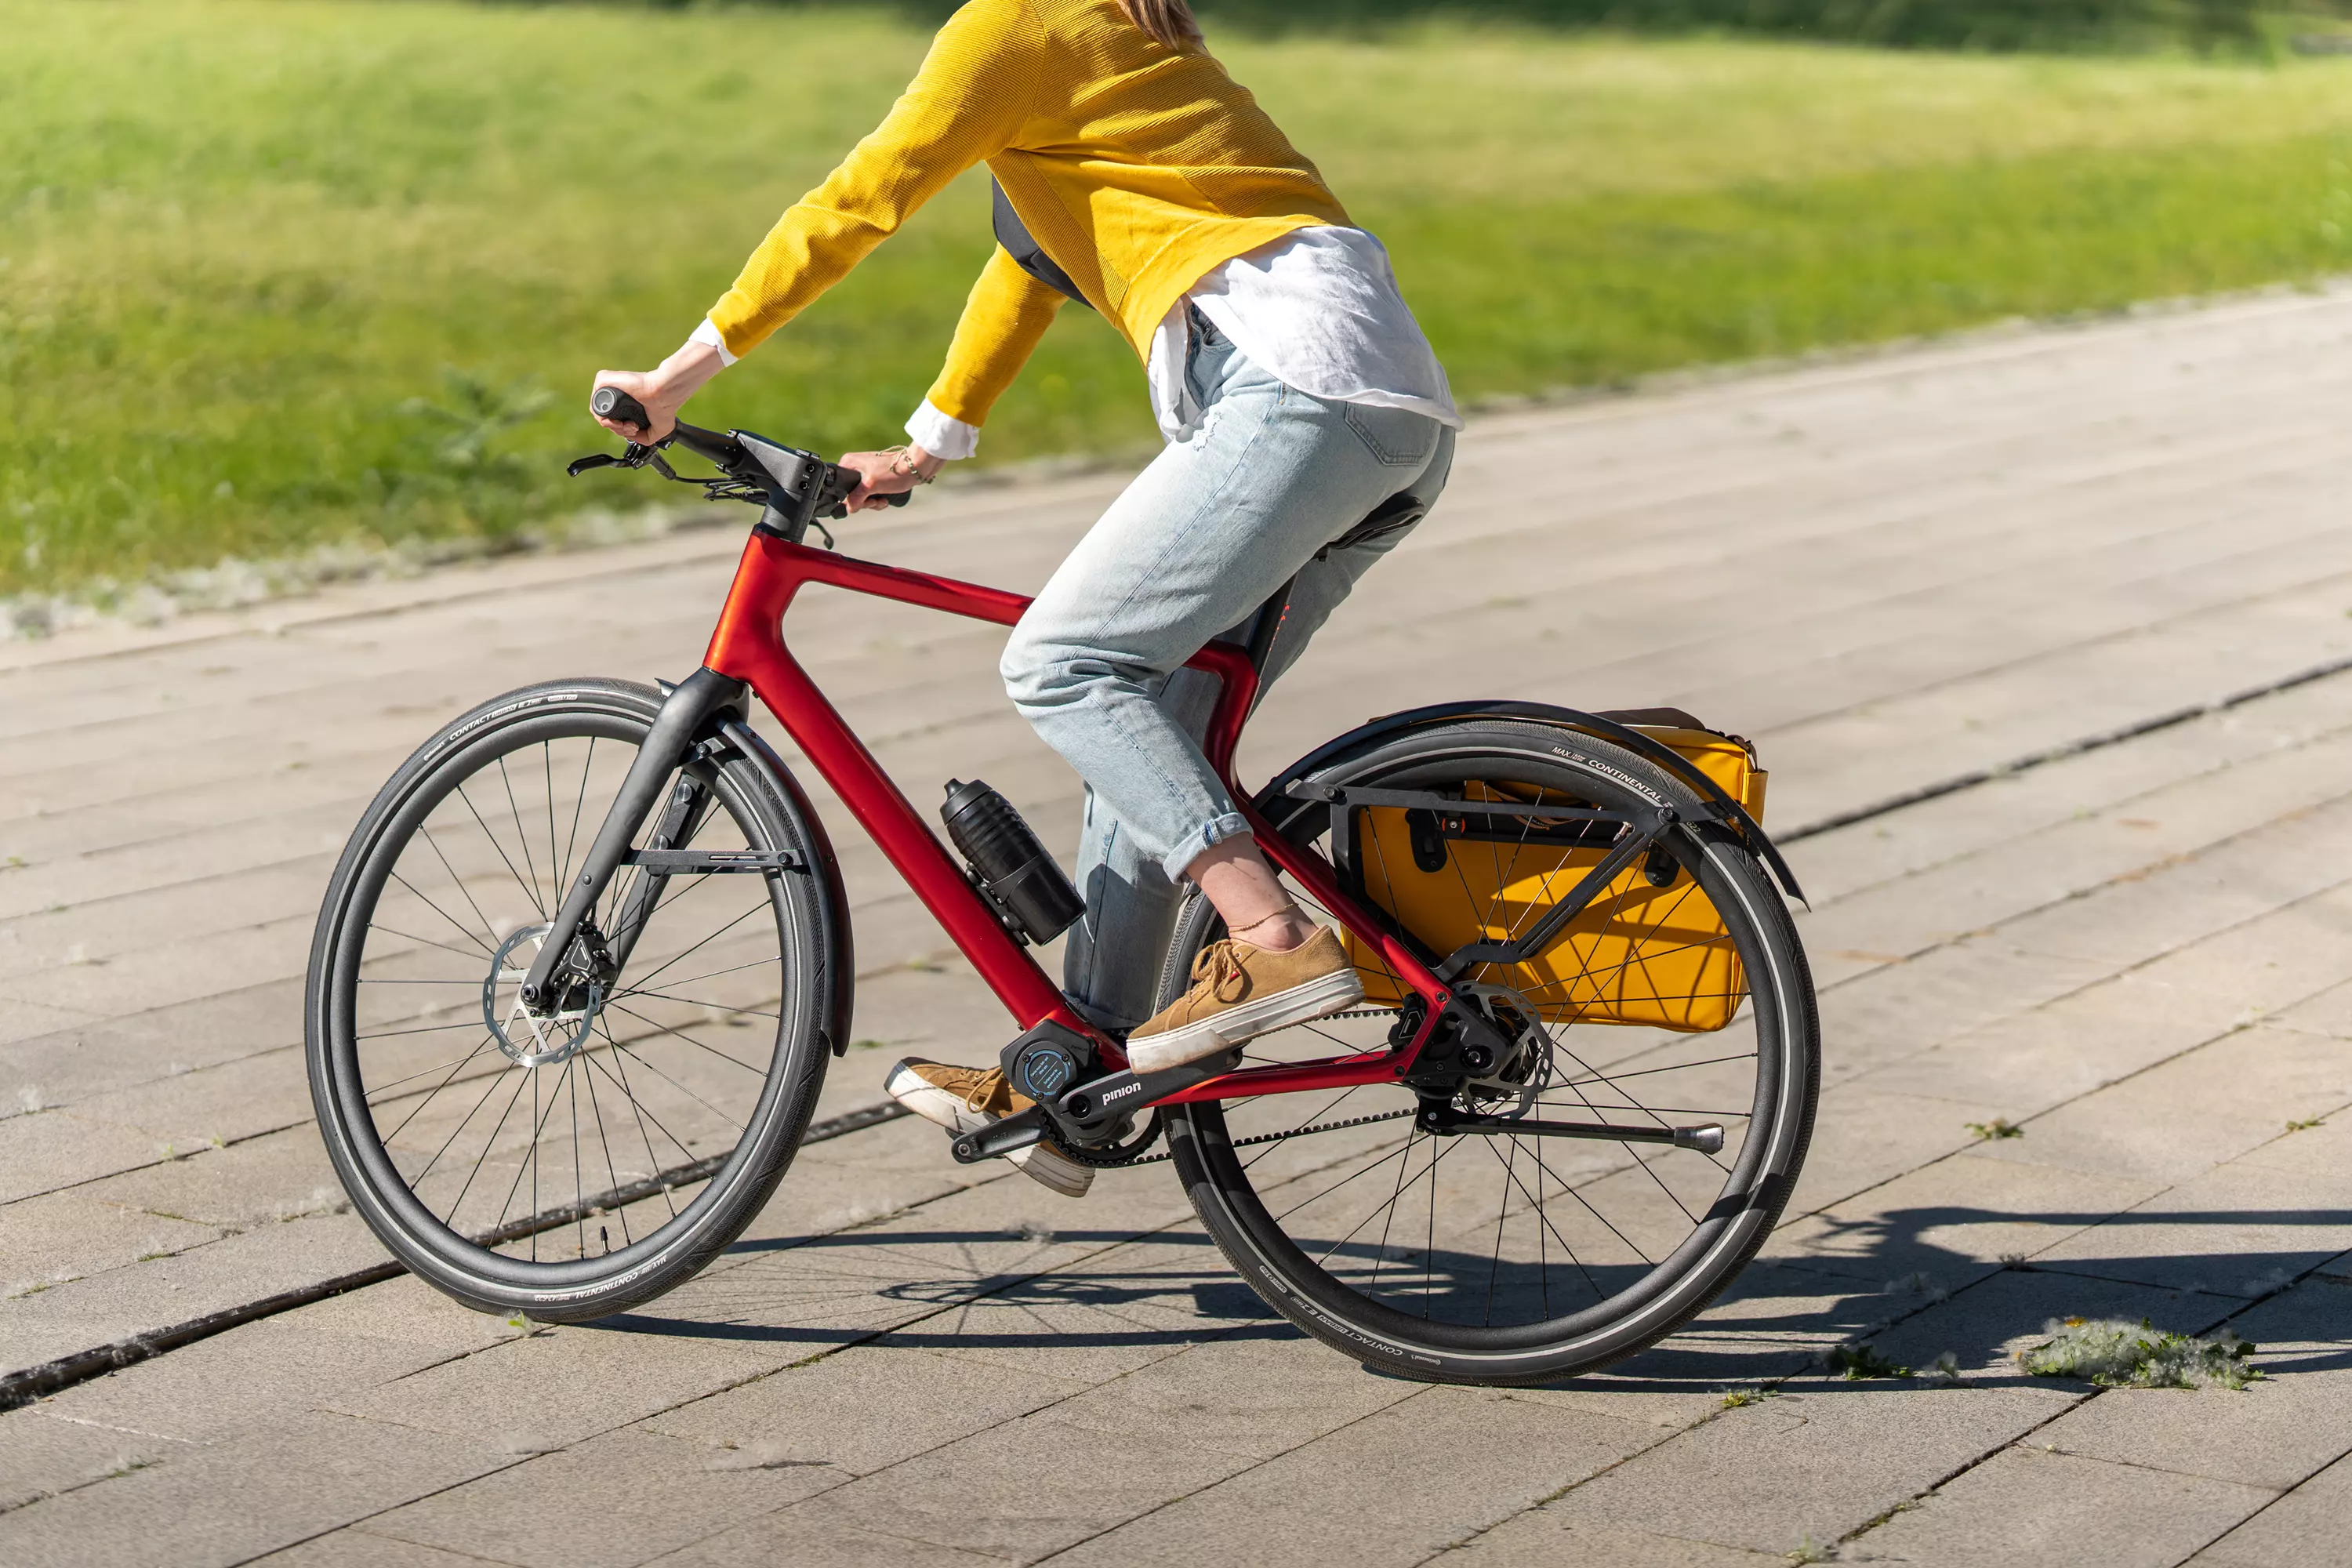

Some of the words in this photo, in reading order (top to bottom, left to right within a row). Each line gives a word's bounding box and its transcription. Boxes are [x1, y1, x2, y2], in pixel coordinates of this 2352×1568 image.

[449, 713, 492, 740] CONTACT
[1552, 746, 1571, 758] MAX.
[1588, 760, 1662, 802] CONTINENTAL
[1102, 1082, 1142, 1105] pinion
[1261, 1266, 1269, 1276] Pro
[575, 1272, 638, 1299] CONTINENTAL
[1273, 1278, 1287, 1292] Safety
[1317, 1316, 1348, 1334] URBAN
[1347, 1333, 1403, 1356] CONTACT
